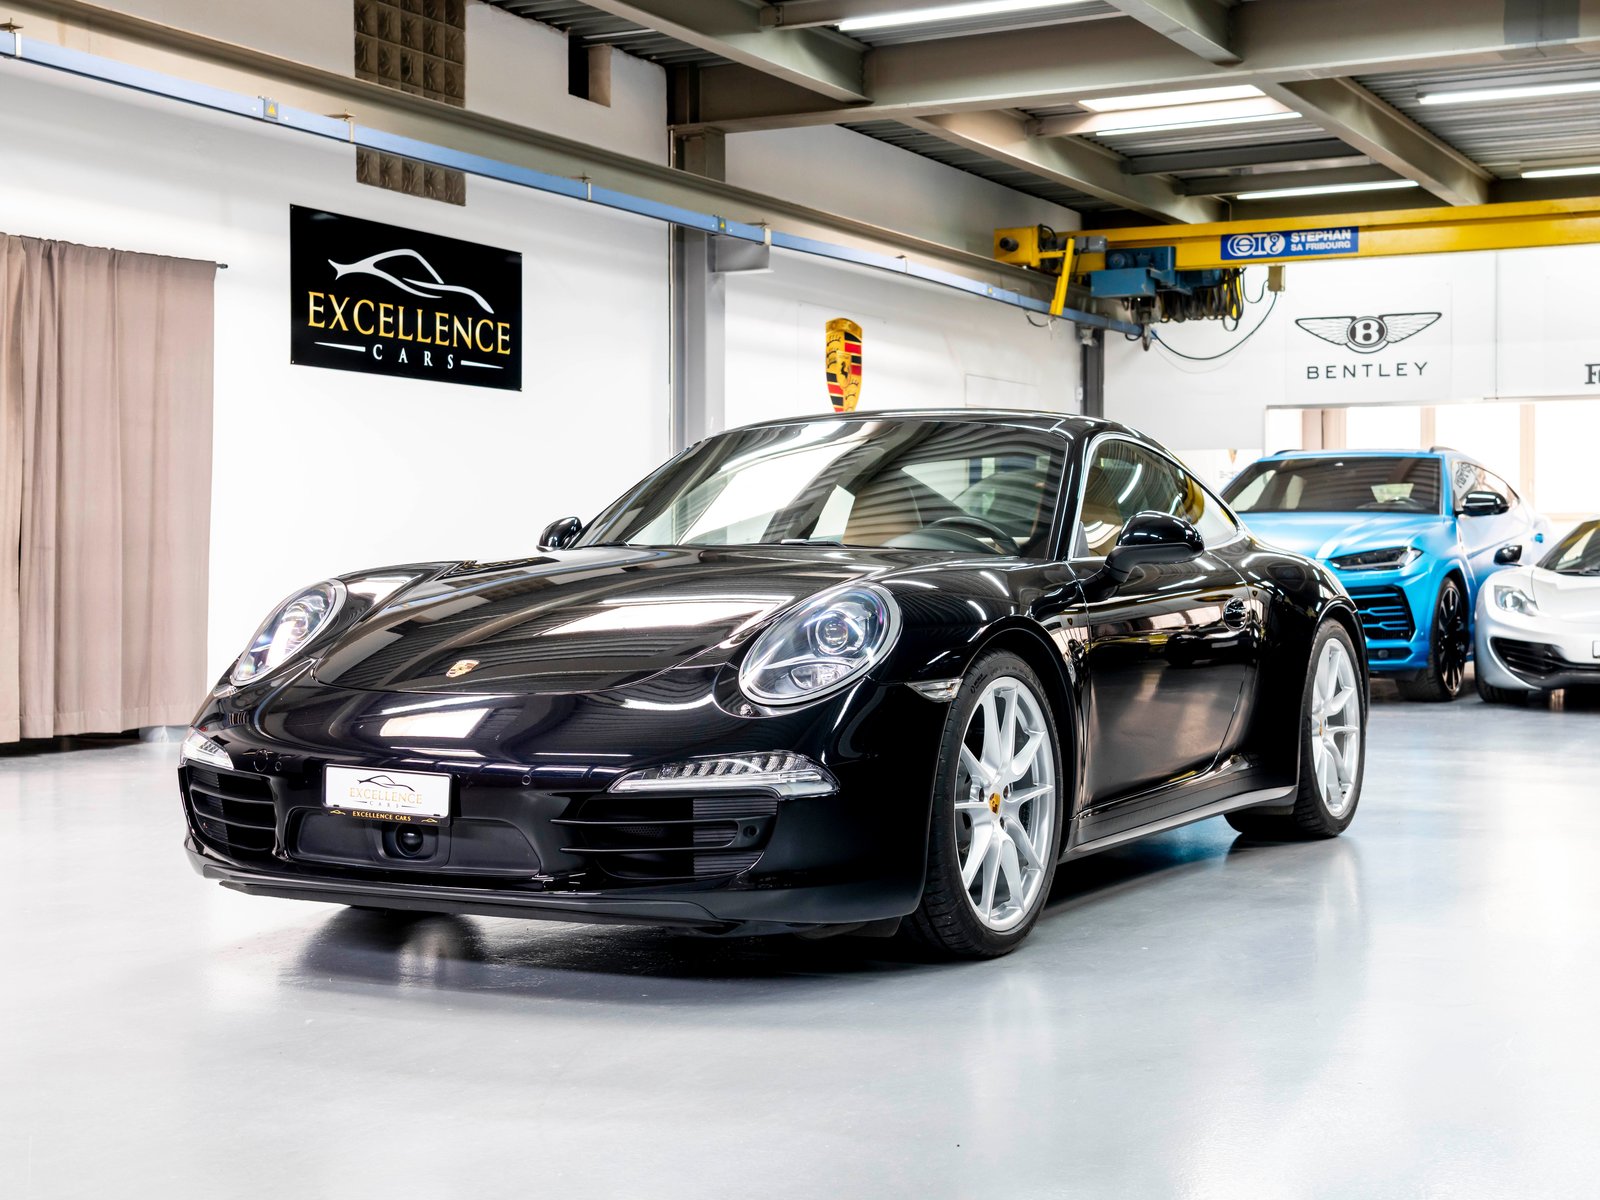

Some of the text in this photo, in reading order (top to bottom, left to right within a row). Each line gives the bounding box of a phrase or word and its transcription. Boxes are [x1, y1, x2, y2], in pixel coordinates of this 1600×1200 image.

[1291, 229, 1351, 242] STEPHAN
[1291, 240, 1351, 251] SA FRIBOURG
[307, 291, 511, 355] EXCELLENCE
[372, 344, 454, 369] CARS
[1307, 362, 1427, 379] BENTLEY
[349, 787, 423, 805] EXCELLENCE
[352, 811, 393, 820] EXCELLENCE
